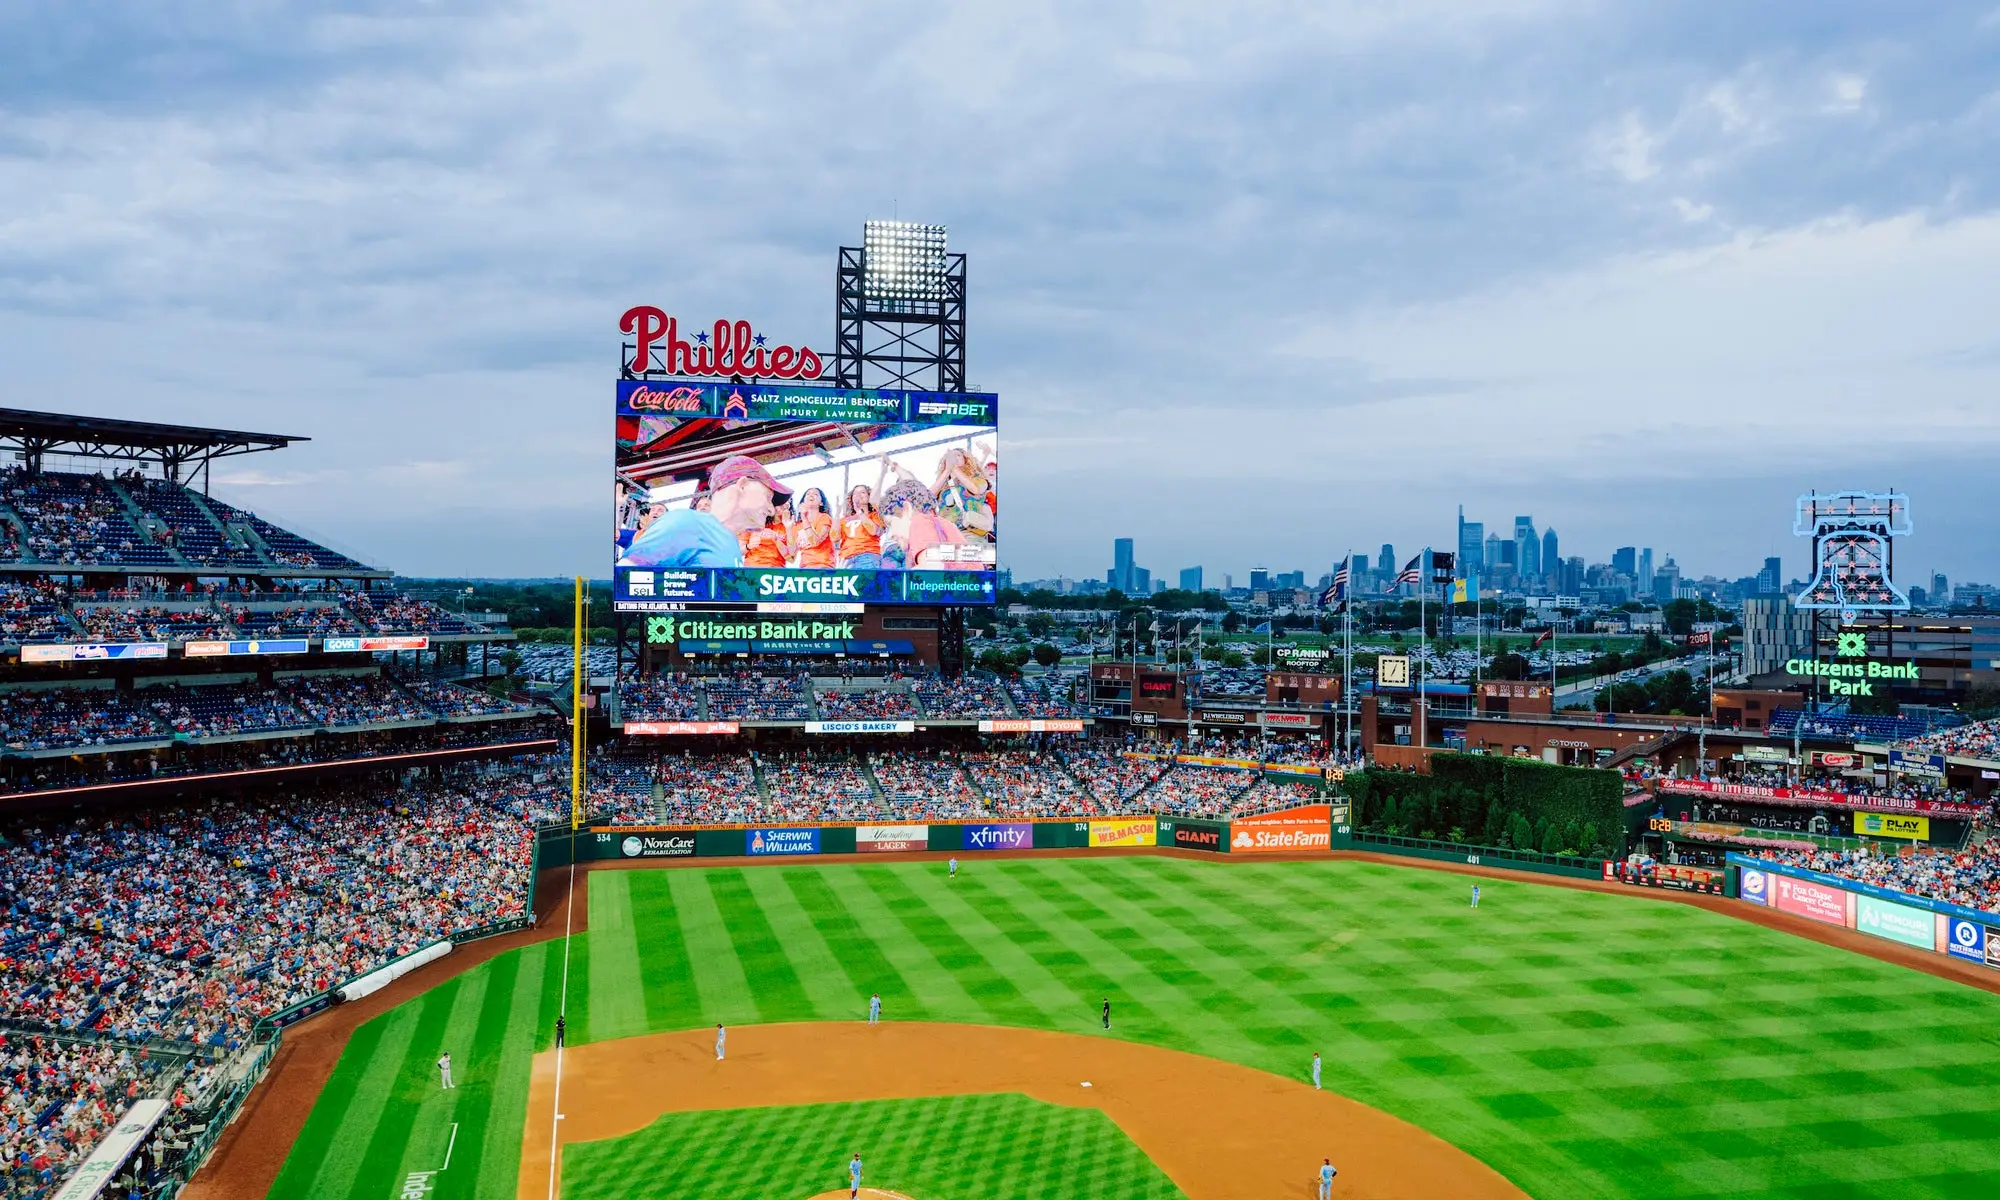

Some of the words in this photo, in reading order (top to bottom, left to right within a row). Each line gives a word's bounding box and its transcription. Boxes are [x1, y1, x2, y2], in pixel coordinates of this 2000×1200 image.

[619, 305, 823, 380] Phillies
[629, 385, 704, 411] Coca-Cola
[751, 393, 780, 403] SALTZ
[785, 395, 847, 406] MONGELUZZI
[851, 397, 900, 407] BENDESKY
[780, 408, 818, 417] INJURY
[825, 410, 872, 419] LAWYERS
[664, 572, 697, 581] Building
[664, 580, 687, 588] brave
[760, 574, 859, 597] SEATGEEK
[910, 581, 980, 592] Independence
[679, 622, 757, 639] Citizens
[761, 622, 808, 639] Bank
[812, 621, 854, 639] Park
[329, 640, 355, 649] GOYA
[1277, 649, 1291, 657] CP
[1292, 650, 1329, 658] RANKIN
[1786, 659, 1864, 677] Citizens
[1868, 660, 1919, 679] Bank
[1143, 682, 1173, 691] GIANT
[1829, 678, 1873, 696] Park
[862, 723, 898, 731] BAKERY
[1560, 740, 1589, 748] TOYOTA
[1326, 769, 1343, 780] 0:28
[1847, 794, 1917, 809] #HITTHEBUDS
[1075, 823, 1087, 832] 374
[1160, 822, 1172, 831] 387
[1650, 819, 1671, 832] 0:28
[1887, 820, 1919, 829] PLAY
[597, 834, 611, 842] 334
[767, 831, 812, 841] SHERWIN
[970, 827, 1025, 847] xfinity
[1176, 830, 1219, 845] GIANT
[643, 837, 695, 849] NovaCare
[766, 842, 812, 852] WILLIAMS
[877, 842, 907, 850] LAGER
[1467, 855, 1480, 865] 401
[1792, 884, 1807, 895] Fox
[1808, 887, 1833, 903] Chase
[1792, 893, 1817, 906] Cancer
[1818, 899, 1842, 911] Center
[1963, 929, 1971, 939] R
